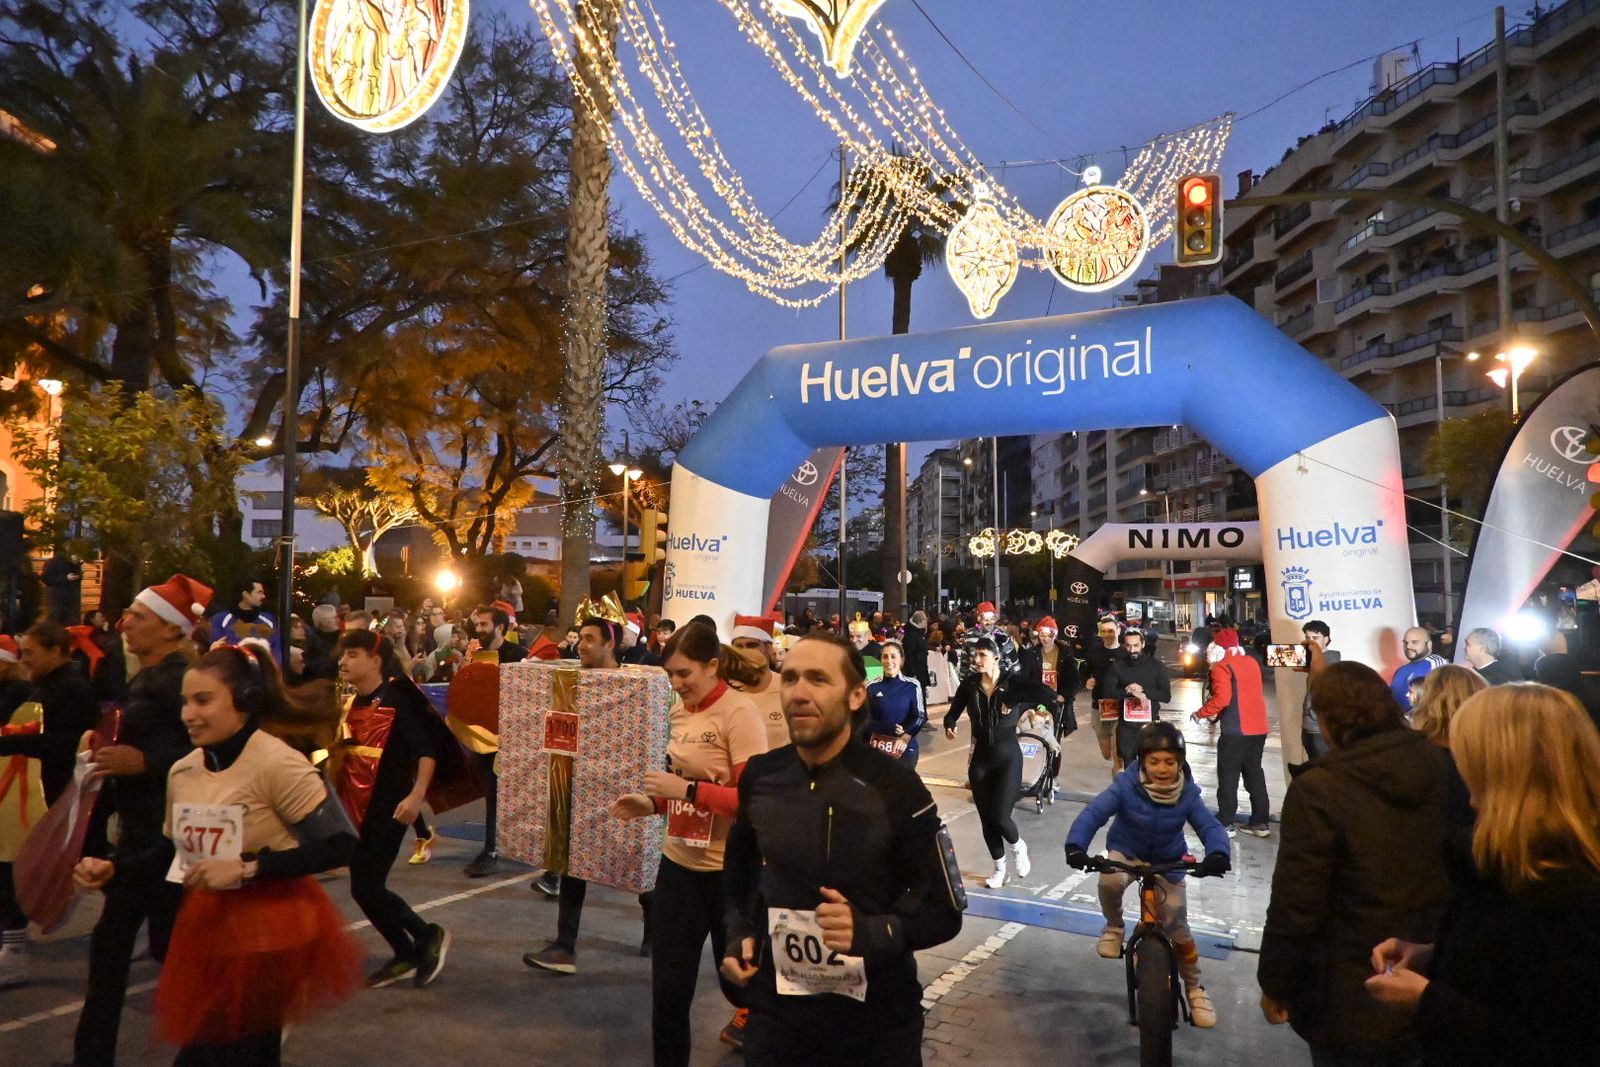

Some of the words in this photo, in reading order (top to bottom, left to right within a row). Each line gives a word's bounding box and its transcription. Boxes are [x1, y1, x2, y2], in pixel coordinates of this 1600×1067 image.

[801, 353, 955, 404] Huelva
[972, 326, 1152, 397] original
[1523, 453, 1586, 495] HUELVA
[1128, 527, 1244, 549] NIMO
[1277, 522, 1377, 550] Huelva
[1342, 547, 1379, 557] original
[675, 589, 716, 601] HUELVA
[1319, 589, 1372, 599] Ayuntamiento
[1319, 597, 1383, 612] HUELVA
[183, 825, 225, 856] 377
